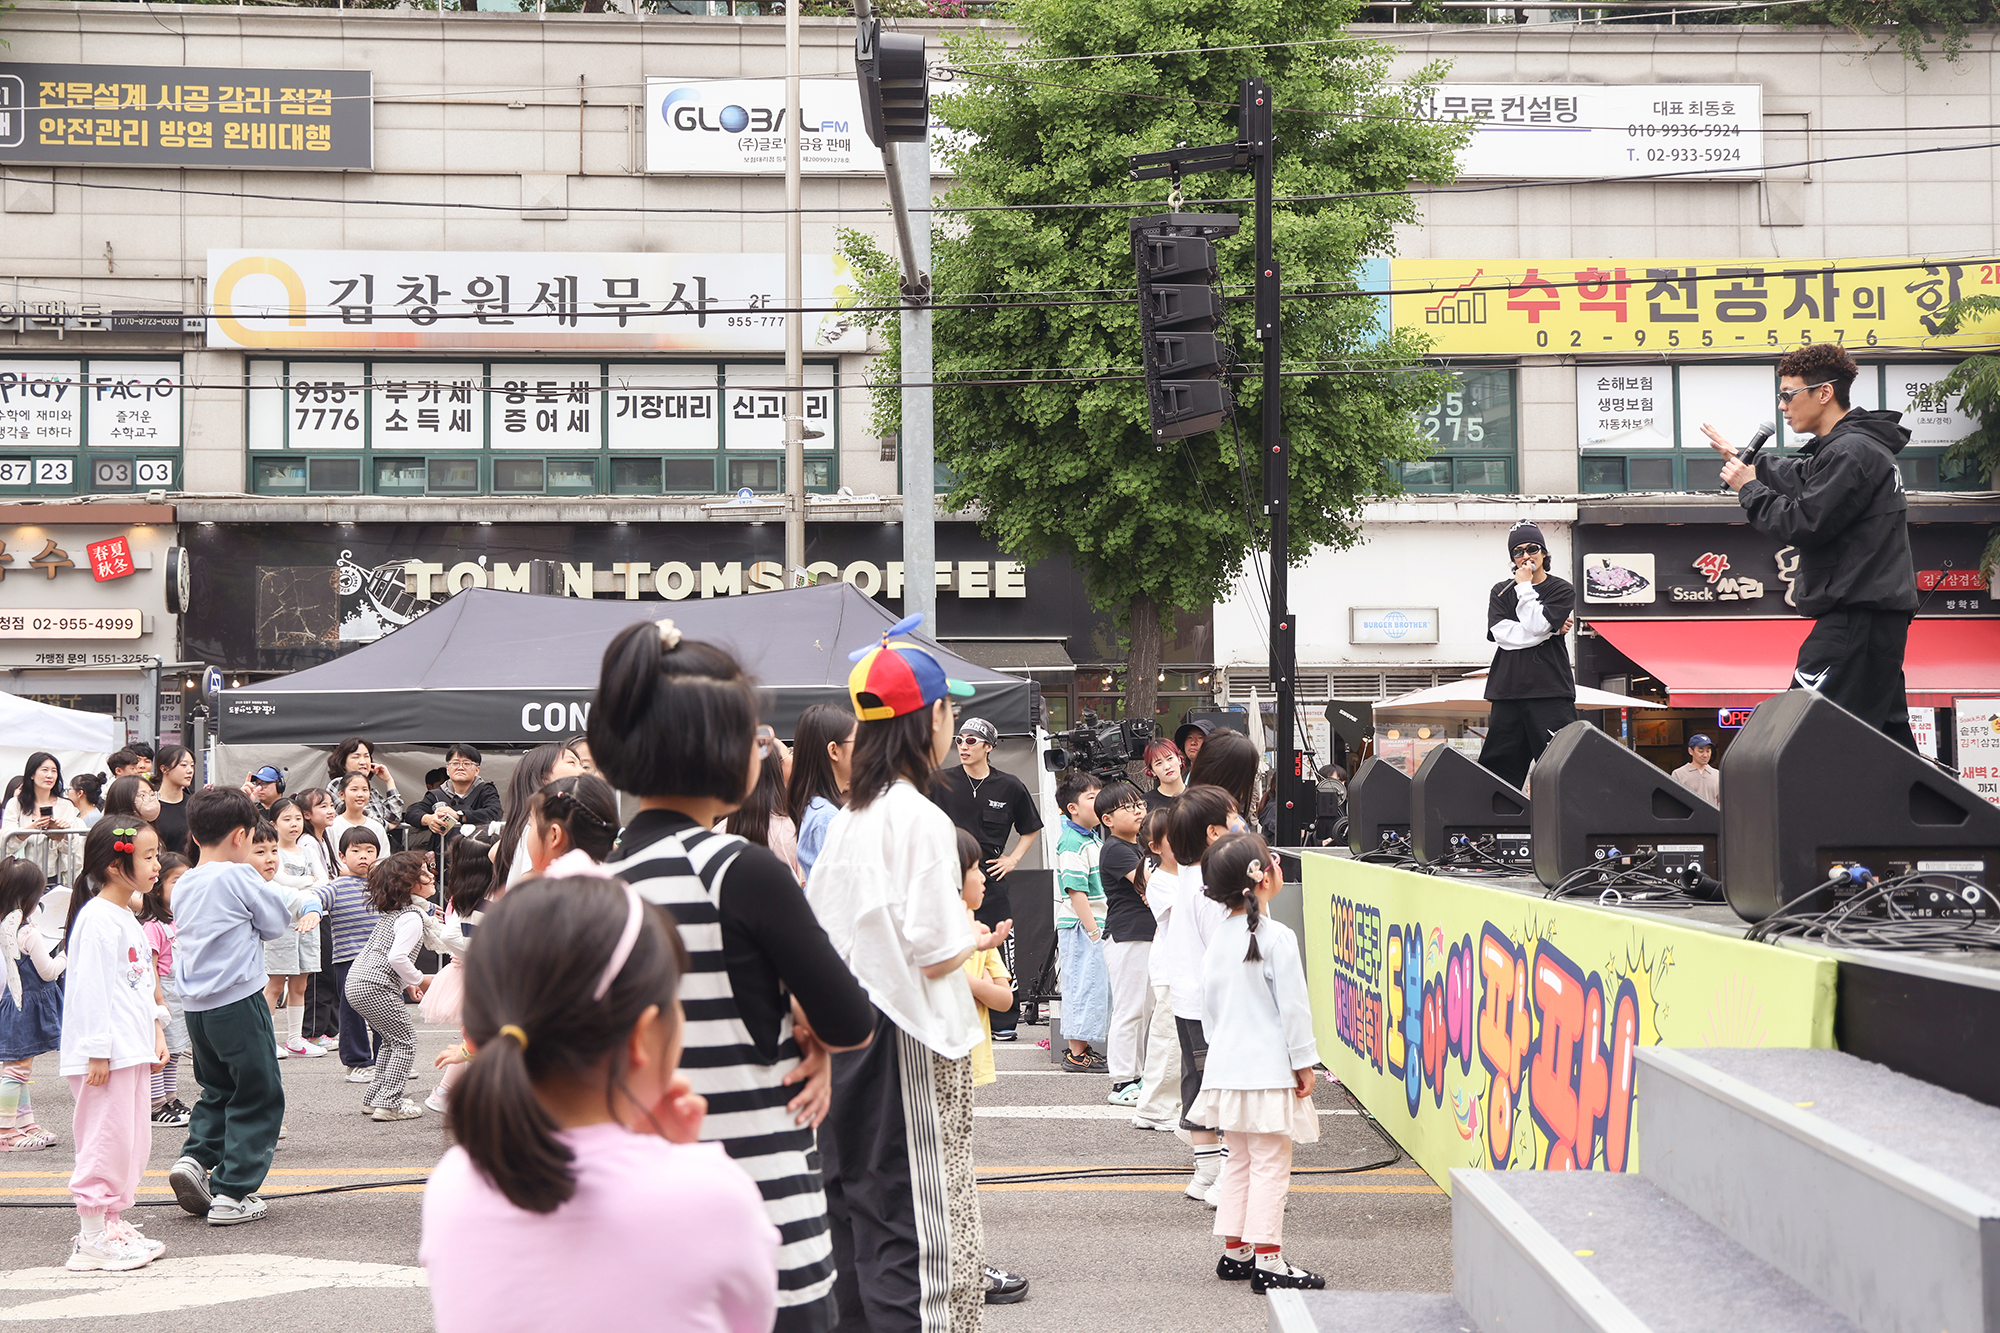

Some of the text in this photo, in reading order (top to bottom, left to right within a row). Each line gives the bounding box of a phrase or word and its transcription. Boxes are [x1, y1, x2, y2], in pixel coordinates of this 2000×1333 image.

[38, 81, 147, 112] 전문설계
[156, 85, 210, 113] 시공
[218, 86, 271, 114] 감리
[279, 87, 332, 116] 점검
[1653, 100, 1736, 117] 대표 최동호
[821, 120, 849, 133] FM
[1627, 123, 1741, 137] 010-9936-5924
[39, 118, 149, 147] 안전관리
[159, 120, 213, 149] 방염
[223, 122, 332, 152] 완비대행
[738, 137, 786, 152] (주)글로
[826, 138, 852, 152] 판매
[1626, 148, 1741, 163] T. 02-933-5924
[328, 273, 719, 329] 김창원세무사
[749, 293, 771, 310] 2F
[727, 316, 785, 328] 955-777
[0, 371, 72, 403] Play
[96, 377, 174, 402] FACTO
[1597, 376, 1653, 391] 손해보험
[294, 380, 360, 404] 955-
[385, 380, 472, 404] 부가세
[503, 380, 590, 405] 양도세
[616, 395, 712, 419] 기장대리
[732, 395, 828, 419] 신고리
[1597, 397, 1654, 412] 생명보험
[36, 409, 73, 422] 재미와
[116, 410, 152, 424] 즐거운
[295, 408, 360, 431] 7776
[385, 408, 472, 433] 소득세
[503, 408, 590, 433] 증여세
[36, 426, 73, 438] 더하다
[110, 426, 158, 440] 수학교구
[0, 463, 169, 482] 87 23 03 03
[612, 560, 784, 601] TOMS
[1673, 586, 1714, 601] Ssack
[1946, 599, 1979, 610] 방학점
[32, 617, 134, 630] 02-955-4999
[1363, 621, 1428, 629] BURGER BROTHER
[35, 653, 150, 664] 가맹점 문의 1551-3255
[1961, 766, 1988, 779] 새벽
[1977, 783, 1998, 793] 까지
[1332, 895, 1355, 973] 2026
